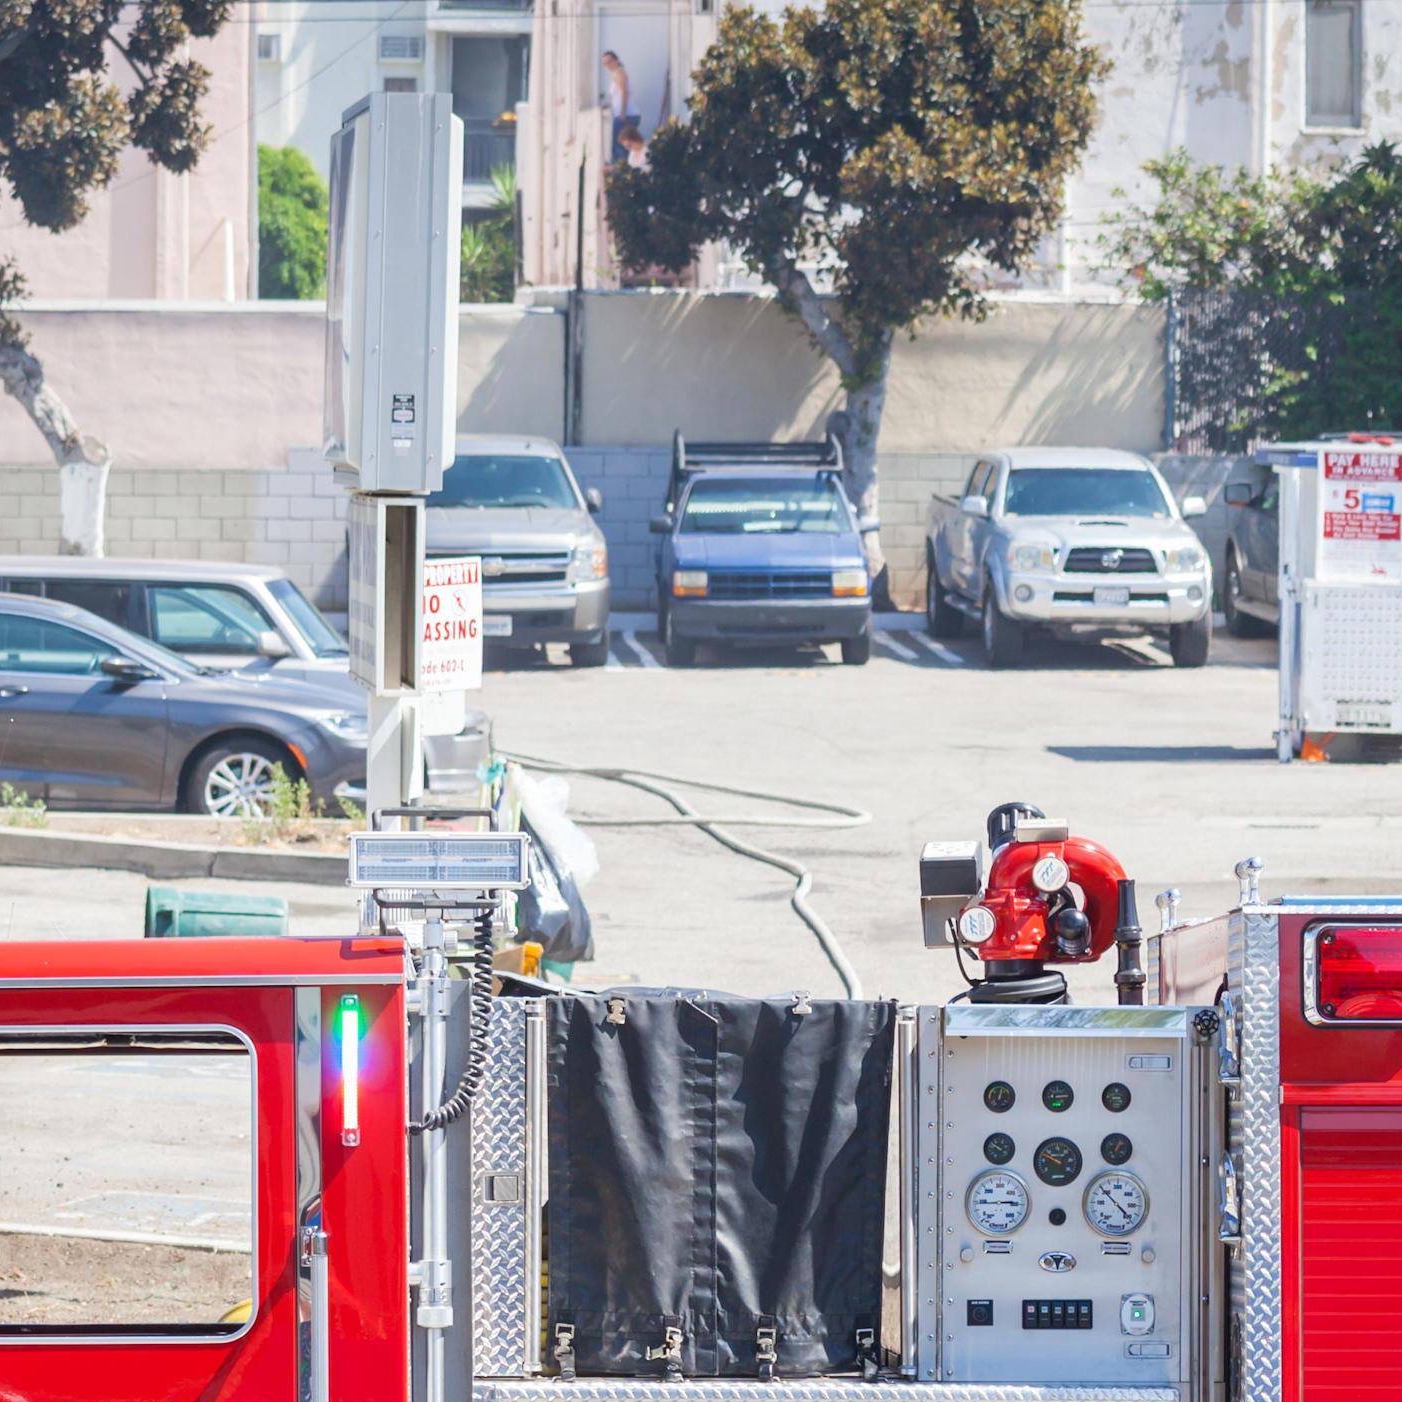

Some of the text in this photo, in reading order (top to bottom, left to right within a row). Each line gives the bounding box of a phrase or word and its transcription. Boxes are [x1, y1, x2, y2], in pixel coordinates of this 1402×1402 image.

[1328, 454, 1399, 468] PAY HERE
[1332, 466, 1395, 477] IN ADVANCE
[1344, 489, 1360, 509] 5
[424, 563, 478, 587] PROPERTY
[423, 618, 477, 642] ASSING
